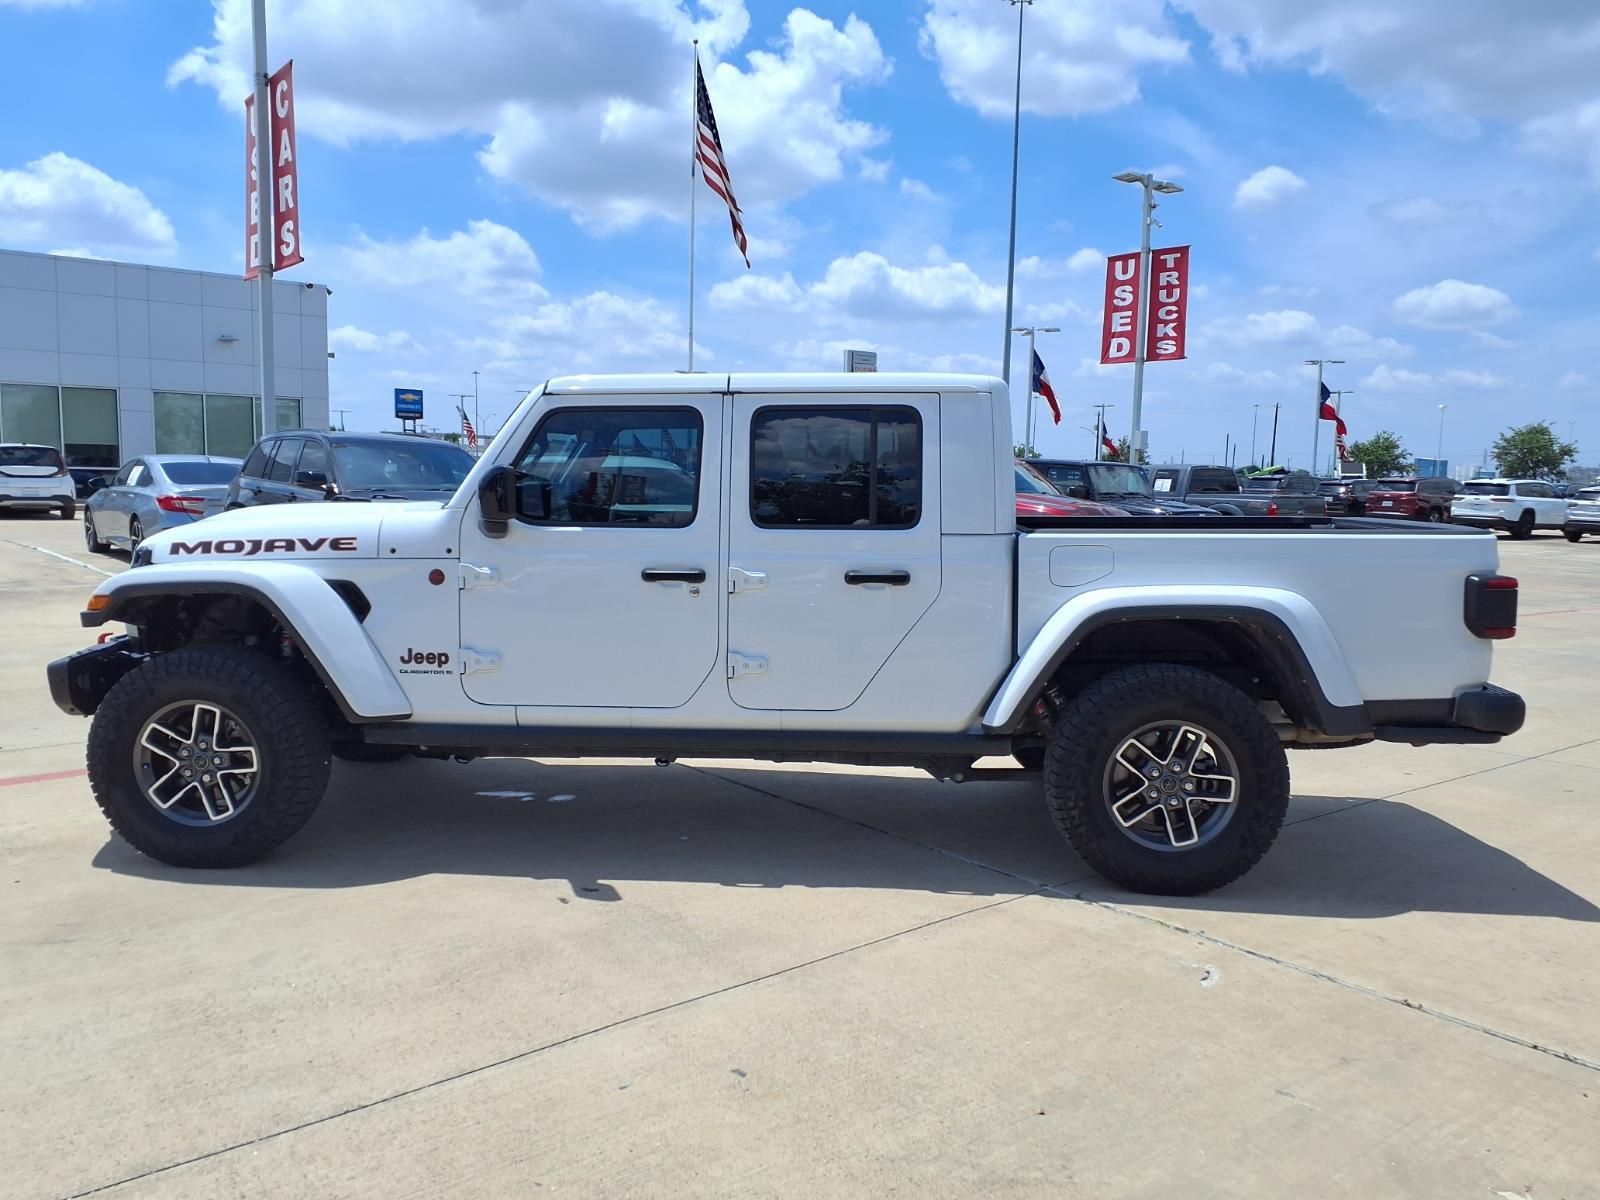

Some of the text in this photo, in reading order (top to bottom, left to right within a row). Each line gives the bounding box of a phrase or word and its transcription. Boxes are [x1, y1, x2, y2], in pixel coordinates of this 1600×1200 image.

[276, 79, 295, 257] CARS
[1109, 258, 1136, 358] USED
[1156, 253, 1181, 355] TRUCKS
[169, 537, 357, 556] MOJAVE
[400, 648, 450, 668] Jeep
